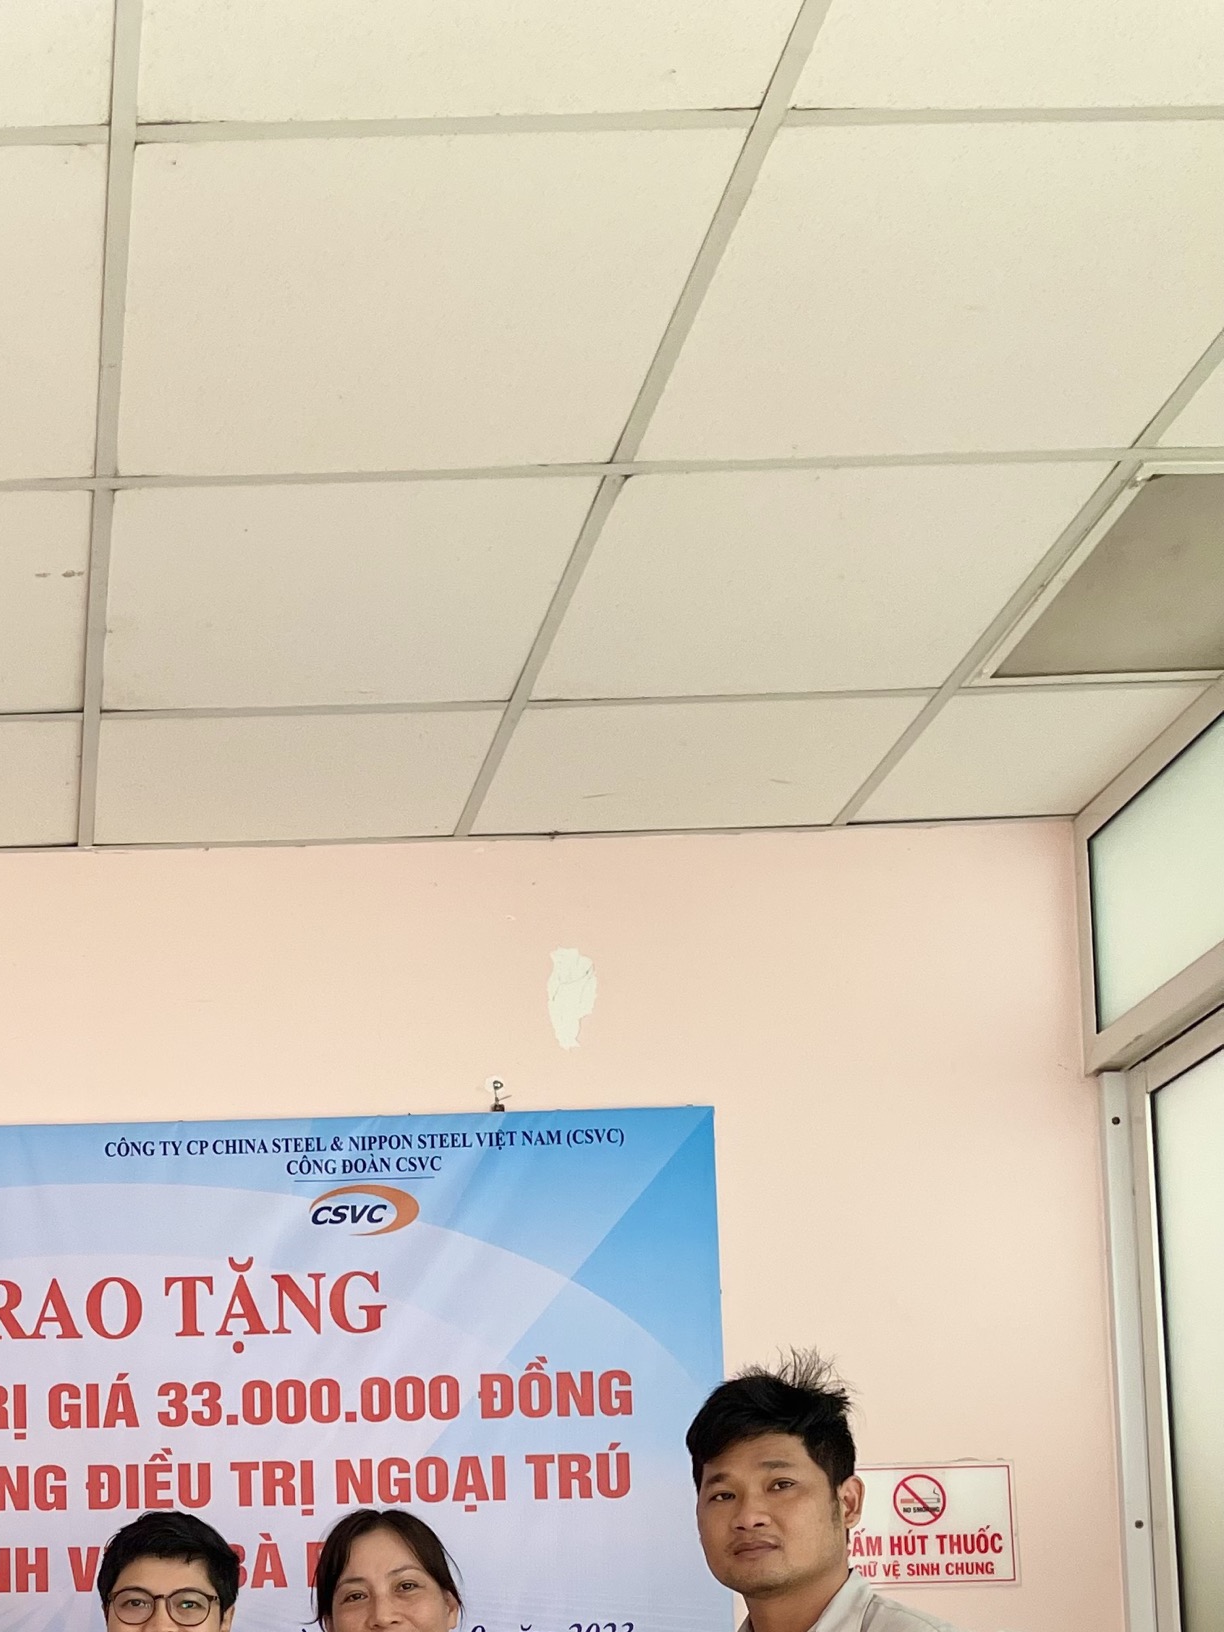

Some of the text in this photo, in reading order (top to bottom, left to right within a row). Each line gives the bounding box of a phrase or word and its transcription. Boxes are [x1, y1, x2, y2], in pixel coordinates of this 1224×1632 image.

[105, 1129, 624, 1158] CÔNG TY CP CHINA STEEL & NIPPON STEEL VIỆT NAM (CSVC)
[287, 1154, 441, 1175] CÔNG ĐOÀN CSVC
[312, 1205, 387, 1225] CSVC
[164, 1256, 386, 1354] TẶNG
[48, 1373, 140, 1430] GIÁ
[158, 1376, 459, 1427] 33.000.000
[477, 1355, 633, 1419] ĐỒNG
[86, 1448, 211, 1510] ĐIỀU
[230, 1460, 314, 1516] TRỊ
[336, 1456, 506, 1511] NGOẠI
[526, 1443, 630, 1499] TRÚ
[852, 1525, 1003, 1557] ẤM HÚT THUỐC
[882, 1560, 900, 1579] VỆ
[907, 1563, 940, 1577] SINH
[945, 1561, 995, 1576] CHUNG
